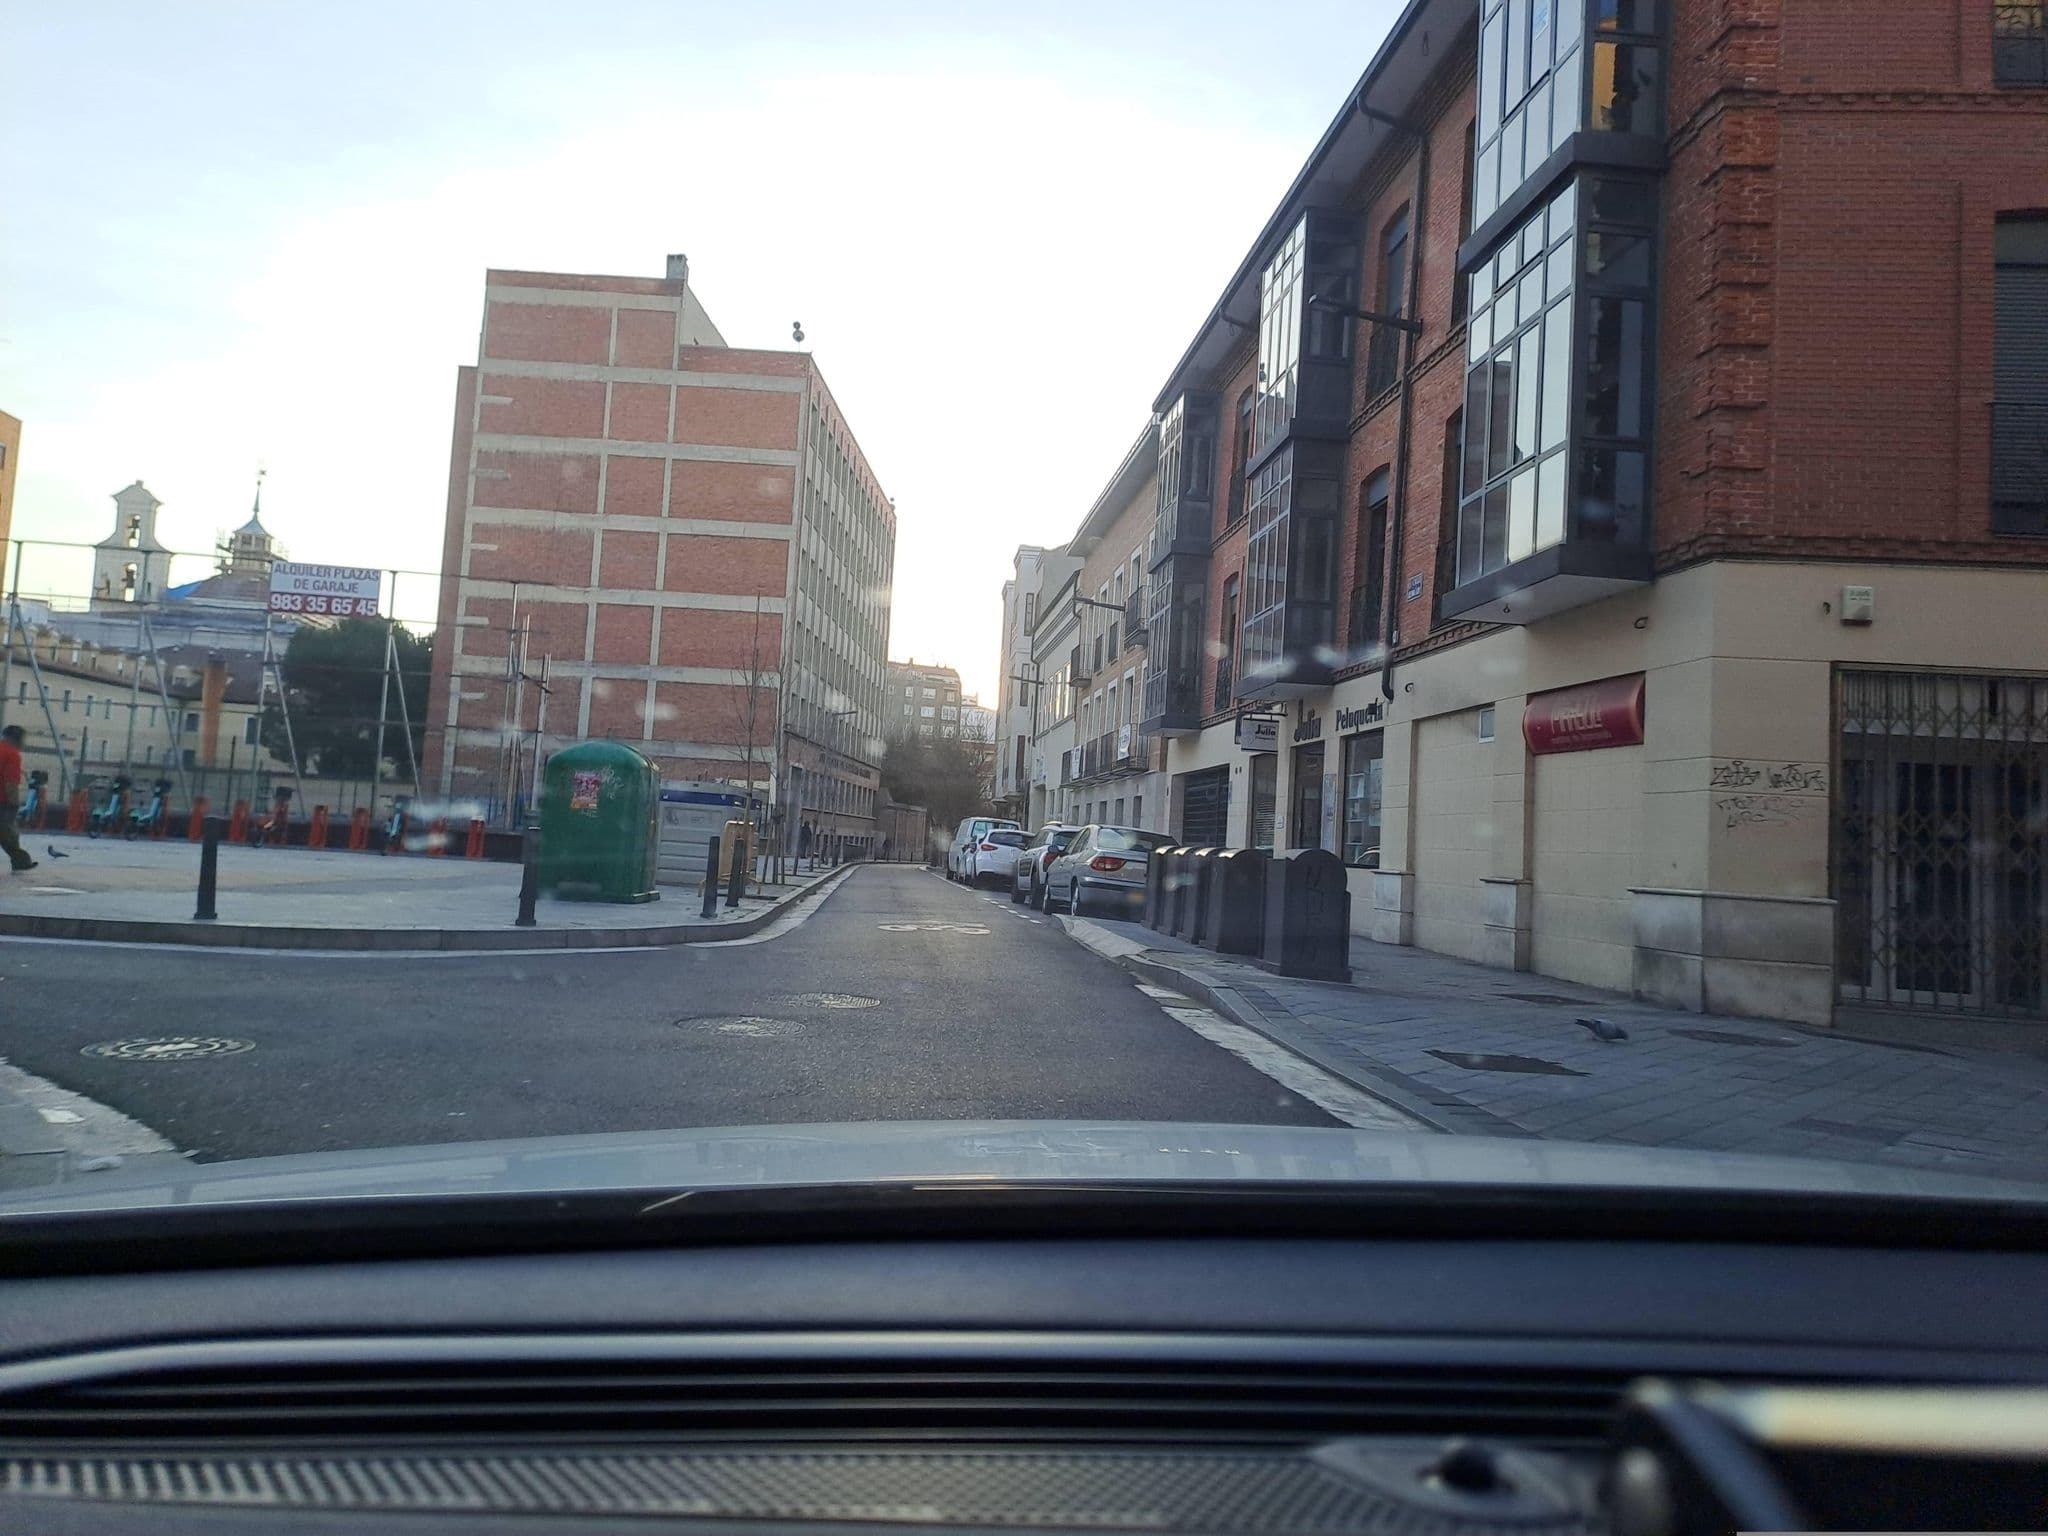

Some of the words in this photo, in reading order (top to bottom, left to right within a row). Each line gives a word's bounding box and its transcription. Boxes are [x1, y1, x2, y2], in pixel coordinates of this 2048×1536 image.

[274, 563, 331, 579] ALQUILER
[334, 568, 379, 582] PLAZAS
[294, 578, 309, 590] DE
[312, 581, 359, 593] GARAJE
[270, 593, 302, 611] 983
[306, 596, 327, 613] 35
[331, 598, 352, 615] 65
[356, 600, 377, 616] 45
